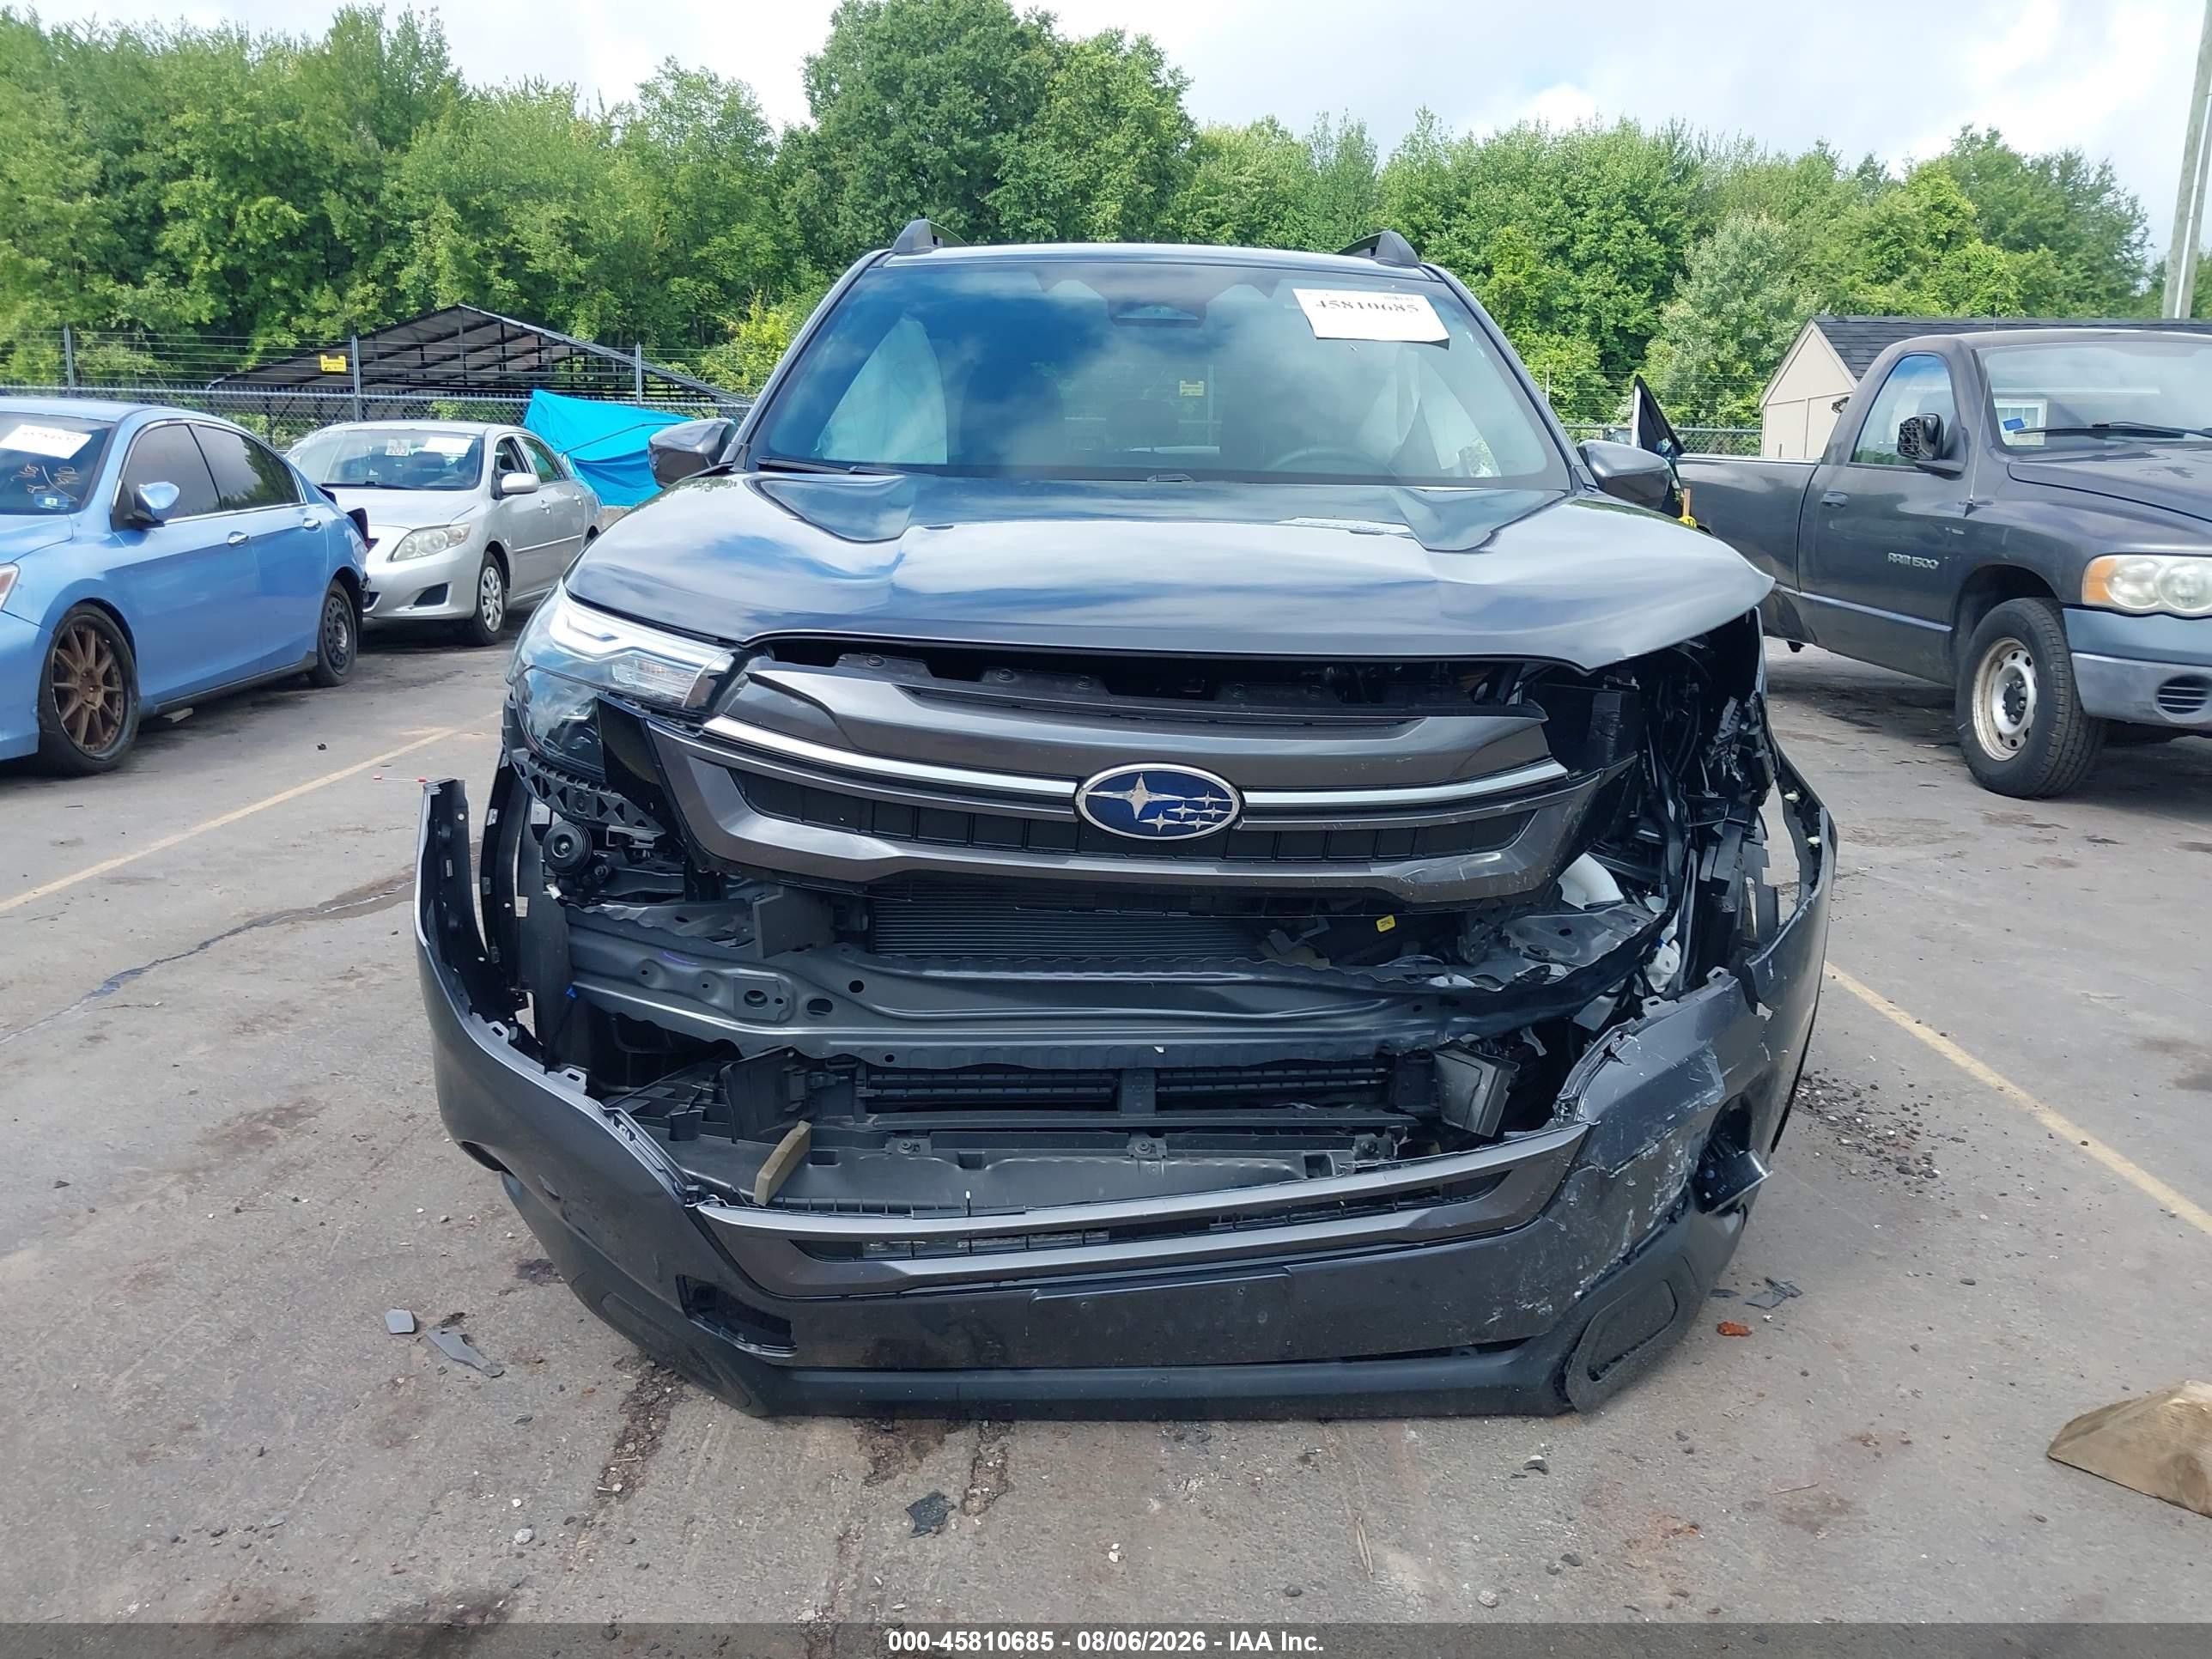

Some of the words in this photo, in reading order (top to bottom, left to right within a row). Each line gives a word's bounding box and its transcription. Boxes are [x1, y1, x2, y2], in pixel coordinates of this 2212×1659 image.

[1316, 300, 1419, 313] 45810685
[389, 446, 407, 455] 203
[1888, 552, 1911, 565] RAM
